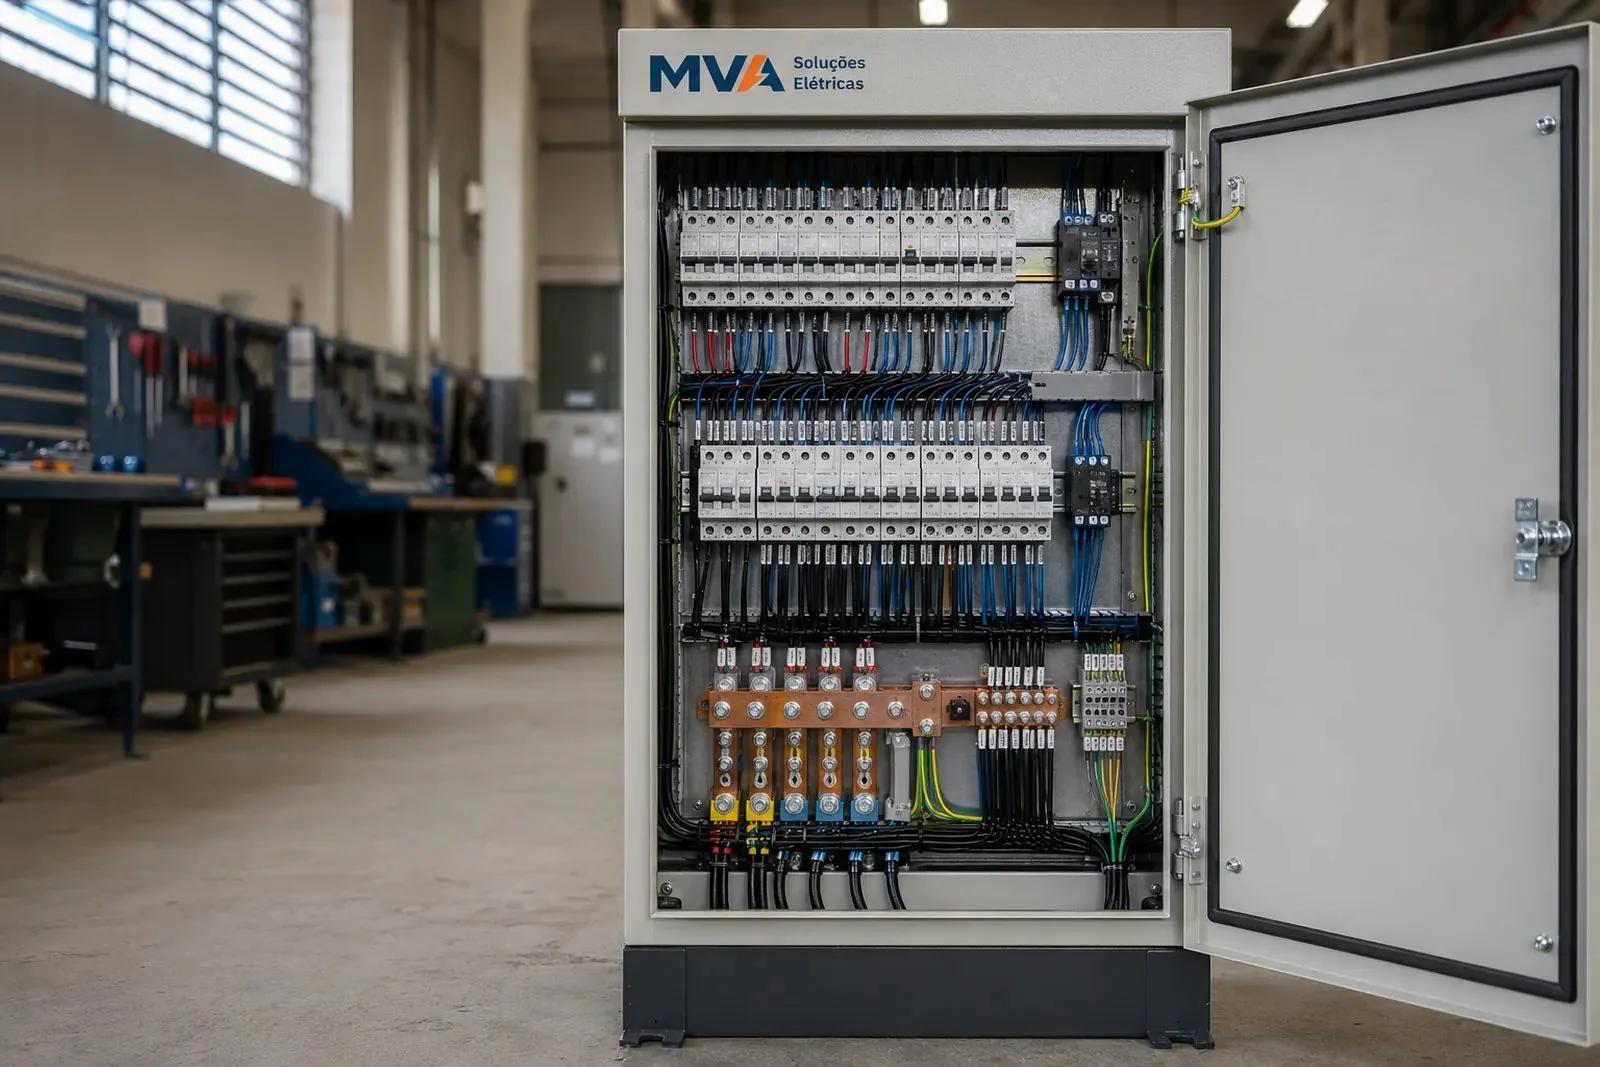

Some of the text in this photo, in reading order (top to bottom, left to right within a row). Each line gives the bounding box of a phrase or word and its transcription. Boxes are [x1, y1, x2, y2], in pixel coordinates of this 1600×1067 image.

[793, 56, 866, 73] Soluções
[650, 55, 785, 92] MVA
[794, 76, 864, 90] Elétricas
